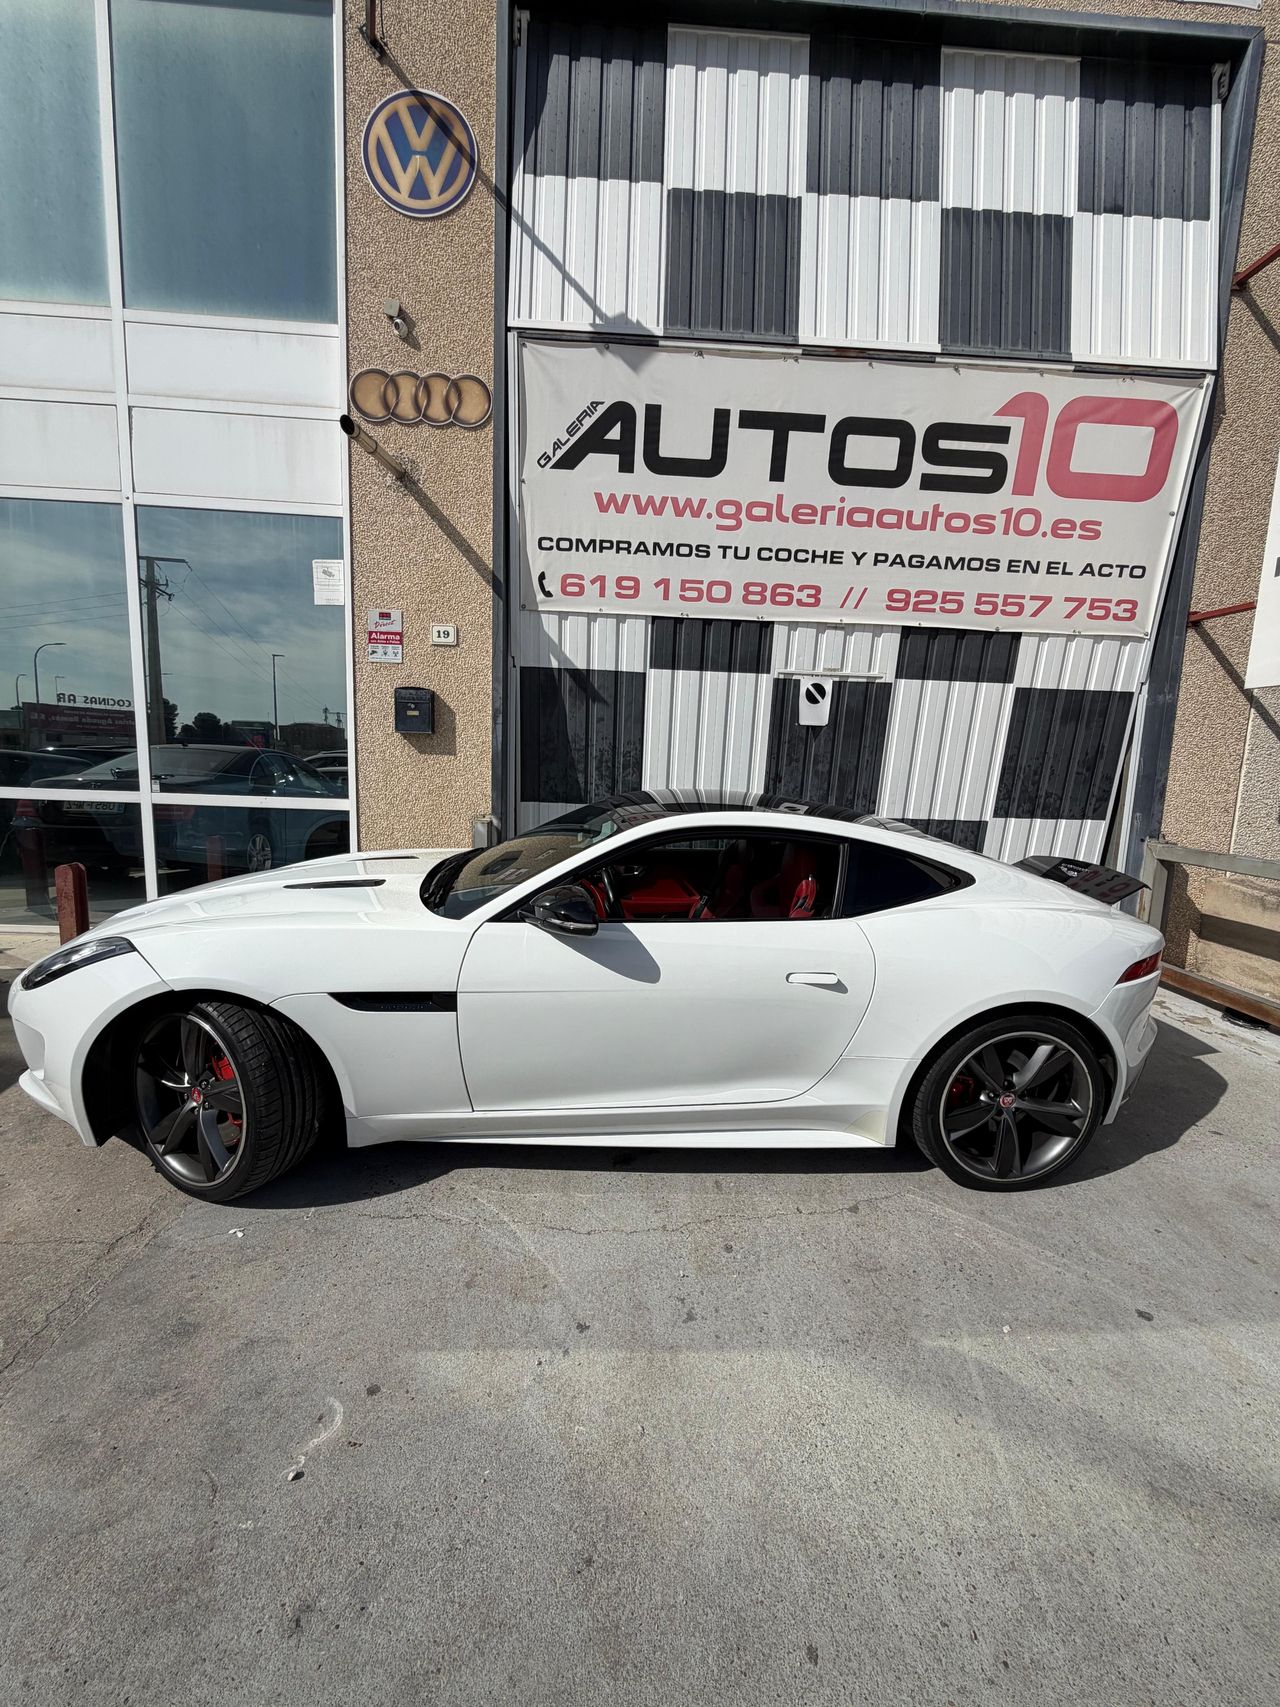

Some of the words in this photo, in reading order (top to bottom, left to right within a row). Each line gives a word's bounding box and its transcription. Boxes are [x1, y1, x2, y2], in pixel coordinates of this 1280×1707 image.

[367, 97, 470, 209] VW
[536, 400, 606, 469] GALERIA
[593, 491, 1103, 541] www.galeriaautos10.es
[537, 536, 711, 559] COMPRAMOS
[718, 545, 750, 561] TU
[757, 547, 844, 565] COCHE
[851, 551, 868, 566] Y
[873, 552, 1001, 573] PAGAMOS
[1006, 559, 1041, 575] EN
[1045, 561, 1073, 577] EL
[1079, 562, 1147, 580] ACTO
[560, 573, 641, 600] 619
[653, 577, 733, 604] 150
[741, 581, 822, 608] 863
[885, 588, 965, 616] 925
[973, 593, 1053, 619] 557
[1063, 596, 1139, 623] 753
[370, 632, 400, 640] Alarma
[436, 630, 450, 639] 19
